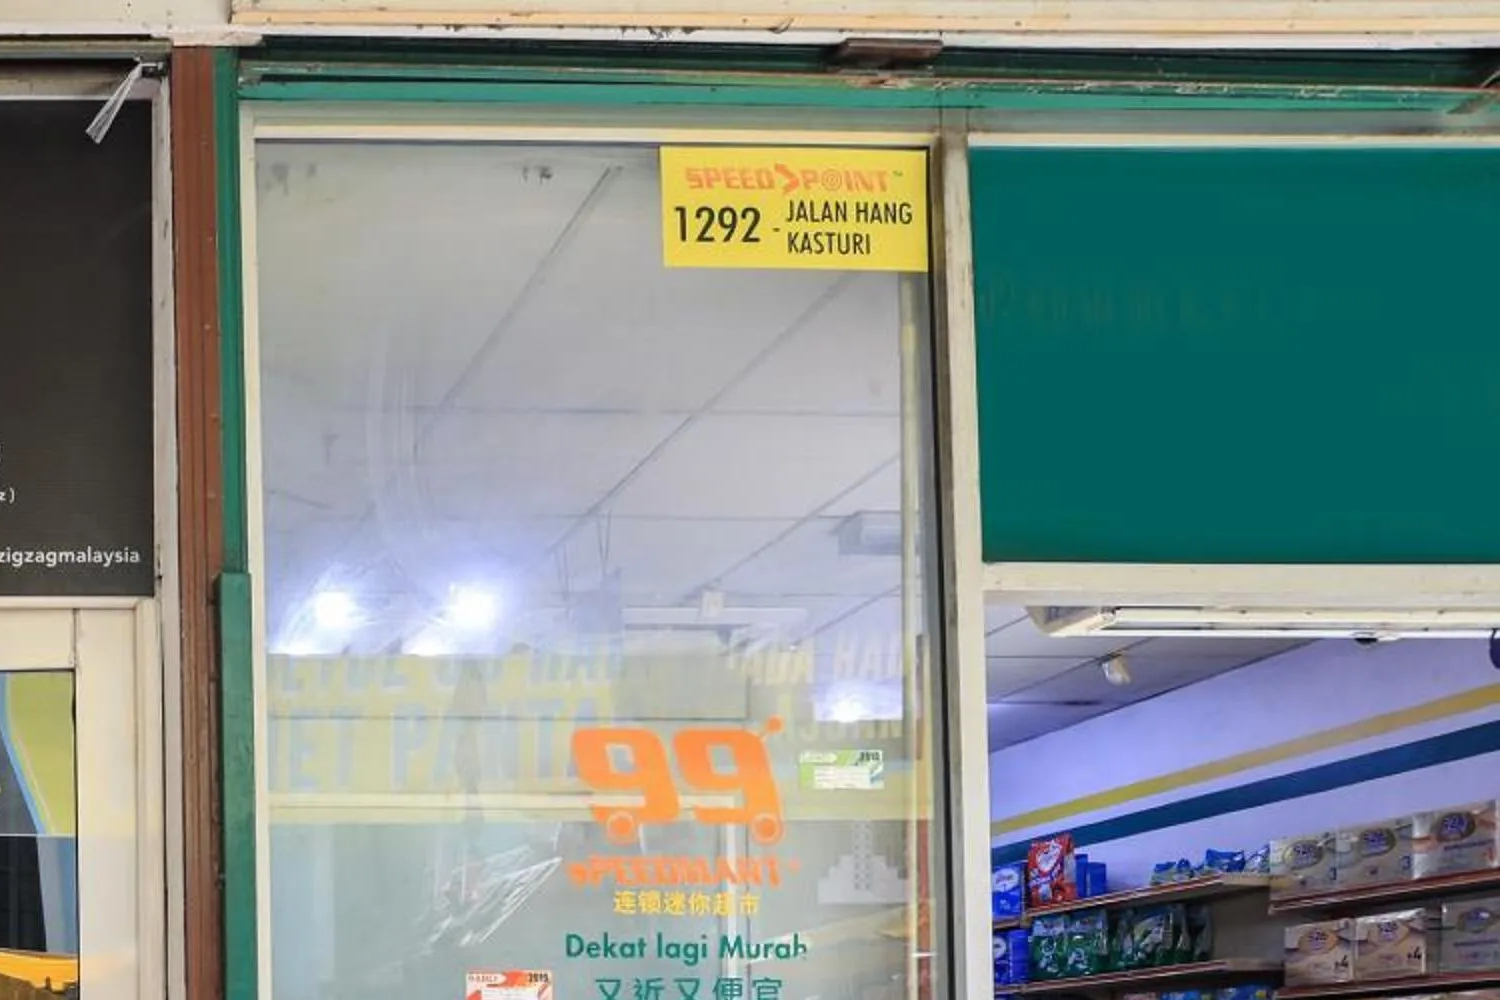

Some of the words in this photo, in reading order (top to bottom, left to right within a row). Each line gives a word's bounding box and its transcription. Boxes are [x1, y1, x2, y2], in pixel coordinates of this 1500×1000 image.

[674, 206, 761, 243] 1292
[785, 200, 848, 224] JALAN
[855, 200, 913, 225] HANG
[787, 231, 871, 255] KASTURI
[570, 722, 784, 846] 99
[565, 932, 647, 959] Dekat
[656, 931, 708, 966] lagi
[718, 932, 809, 960] Murah
